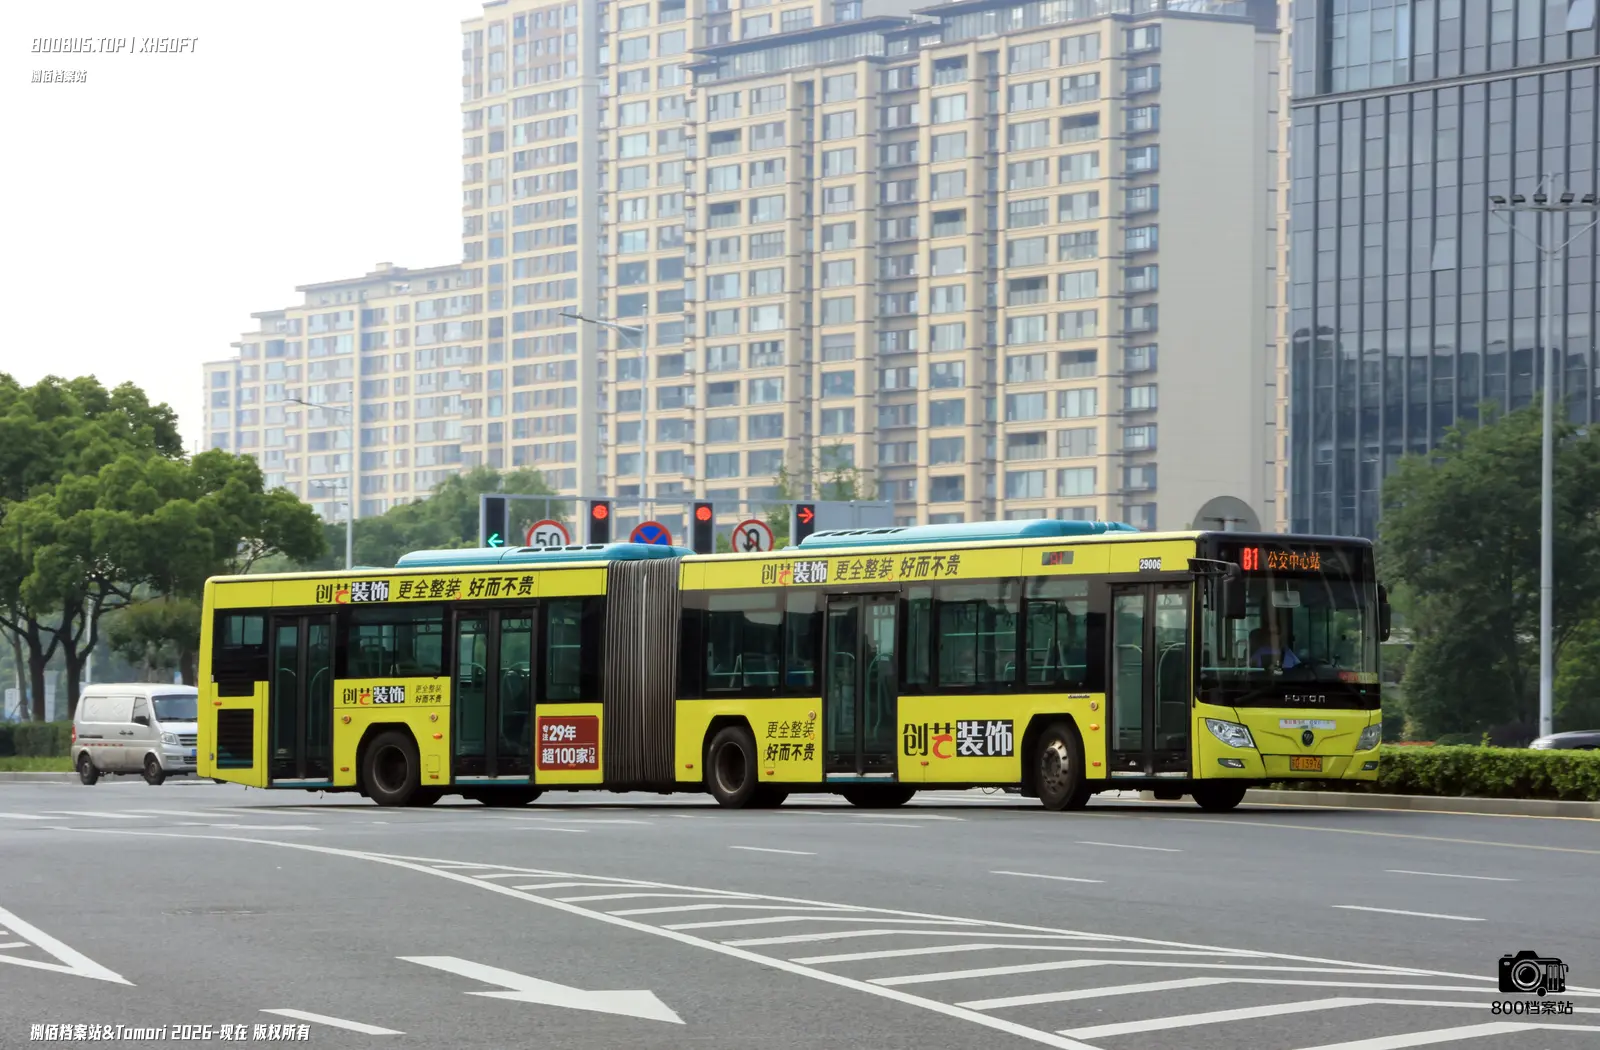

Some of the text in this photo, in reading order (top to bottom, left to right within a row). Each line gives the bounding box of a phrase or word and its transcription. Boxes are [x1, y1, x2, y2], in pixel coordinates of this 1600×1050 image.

[535, 532, 561, 546] 50
[761, 554, 961, 585] 创艺装饰 更全整装 好而不贵
[1139, 558, 1161, 570] 29006
[1267, 551, 1320, 571] 公交中心站
[316, 575, 534, 604] 创艺装饰 更全整装 好而不贵
[343, 685, 405, 705] 创艺装饰
[1284, 694, 1325, 703] FOTON
[765, 721, 815, 740] 更全整装
[903, 719, 1014, 759] 创艺装饰
[766, 743, 815, 761] 好而不贵
